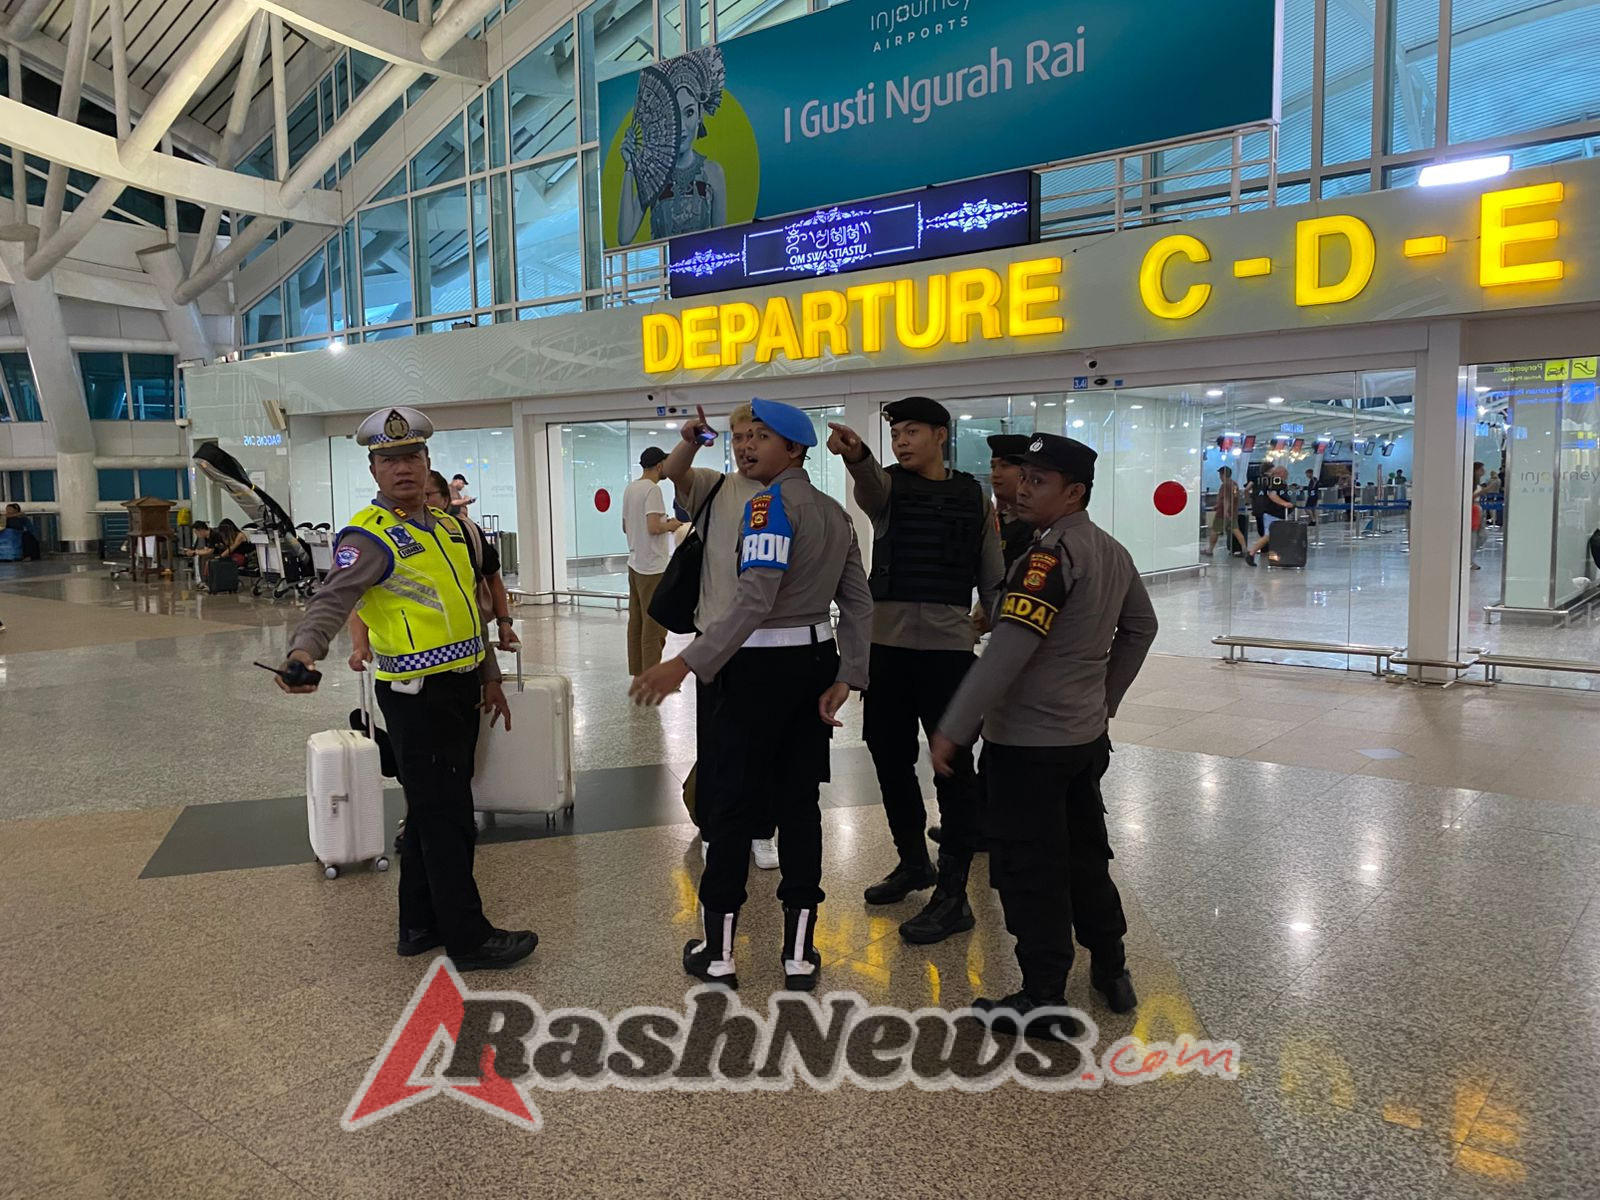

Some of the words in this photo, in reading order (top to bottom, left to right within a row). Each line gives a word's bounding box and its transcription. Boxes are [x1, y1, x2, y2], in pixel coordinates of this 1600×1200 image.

[873, 16, 968, 52] AIRPORTS
[784, 107, 791, 143] I
[800, 82, 875, 138] Gusti
[886, 47, 1013, 123] Ngurah
[1026, 26, 1085, 85] Rai
[790, 253, 805, 265] OM
[807, 243, 867, 263] SWASTIASTU
[642, 257, 1063, 374] DEPARTURE
